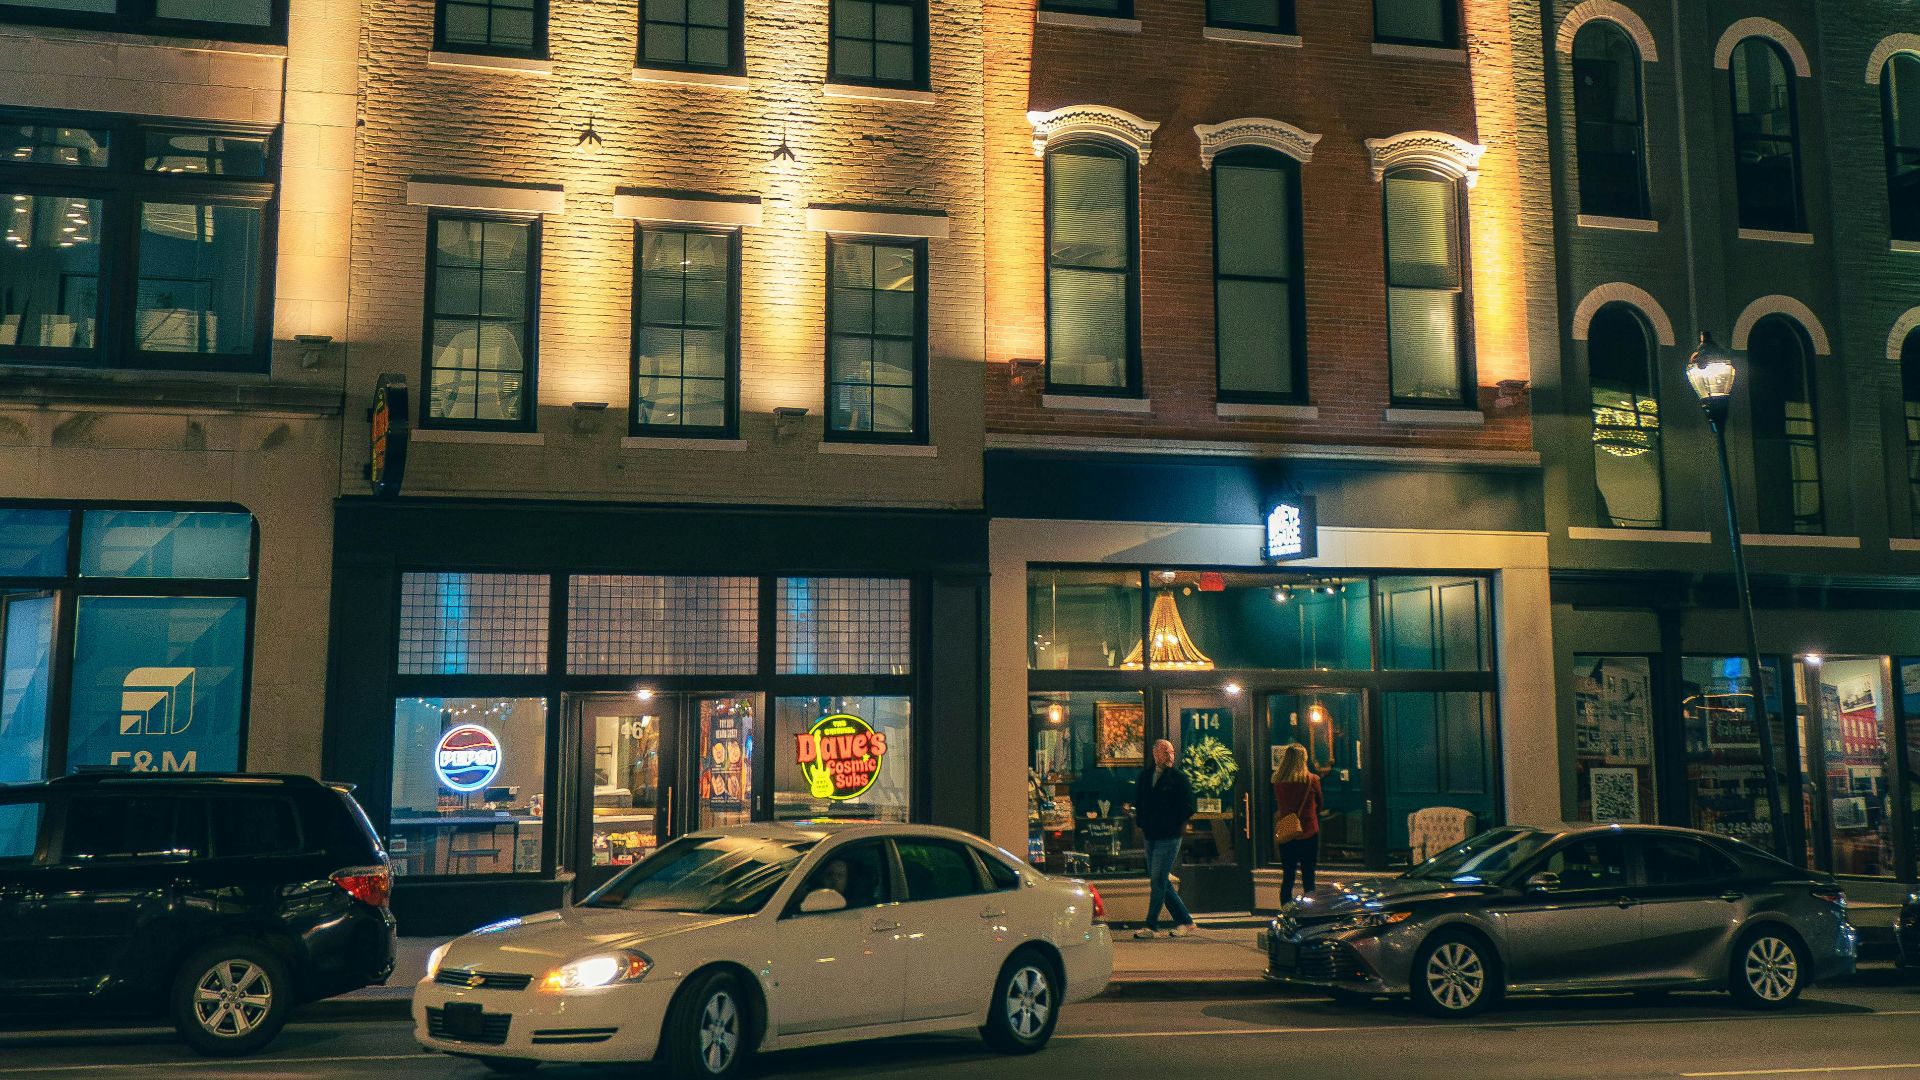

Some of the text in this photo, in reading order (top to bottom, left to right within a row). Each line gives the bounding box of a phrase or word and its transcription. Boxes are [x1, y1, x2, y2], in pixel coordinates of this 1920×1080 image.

[1192, 713, 1220, 730] 114
[796, 730, 887, 763] Dave's
[440, 750, 496, 767] PEPSI
[826, 758, 877, 775] Cosmic
[836, 773, 869, 789] Subs
